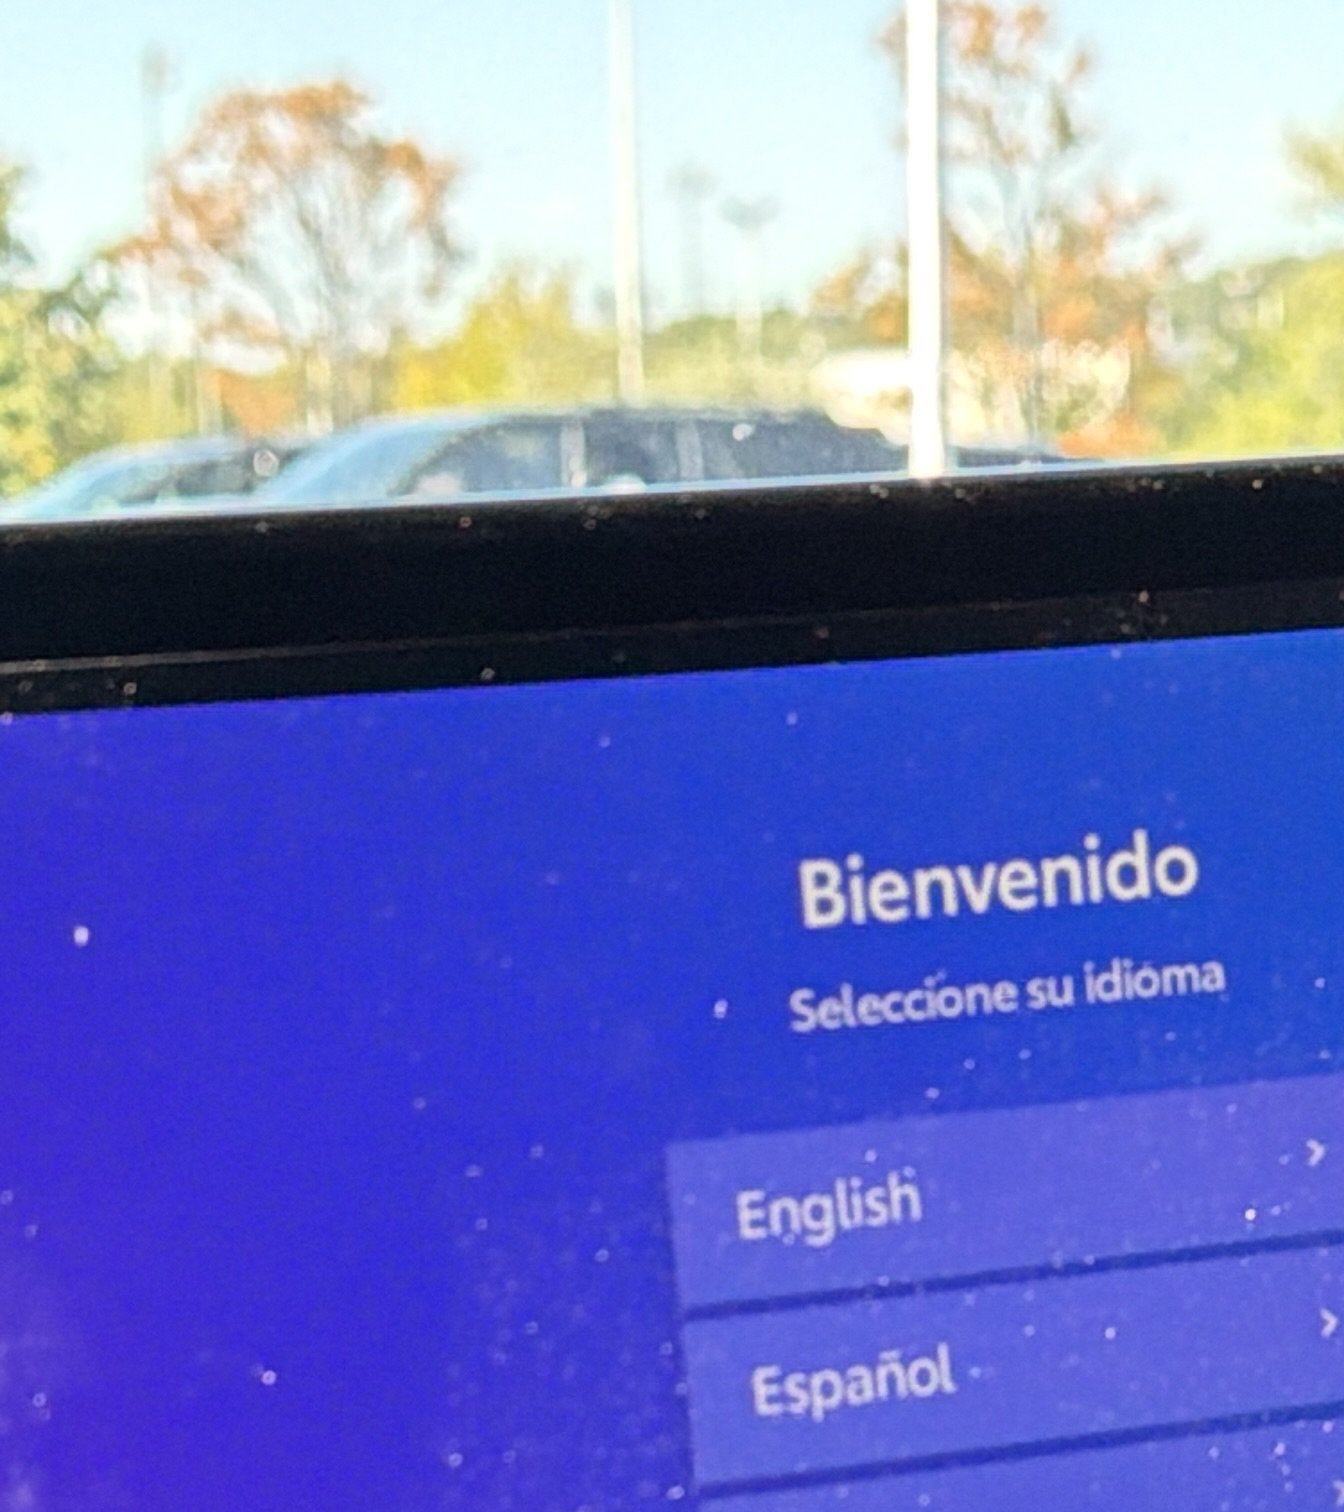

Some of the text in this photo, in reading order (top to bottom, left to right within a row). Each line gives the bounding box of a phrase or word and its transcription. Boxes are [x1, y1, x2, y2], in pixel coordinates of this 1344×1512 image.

[799, 828, 1199, 929] Bienvenido
[789, 958, 1227, 1033] Seleccione su idioma
[736, 1168, 923, 1247] English
[751, 1343, 957, 1422] Español
